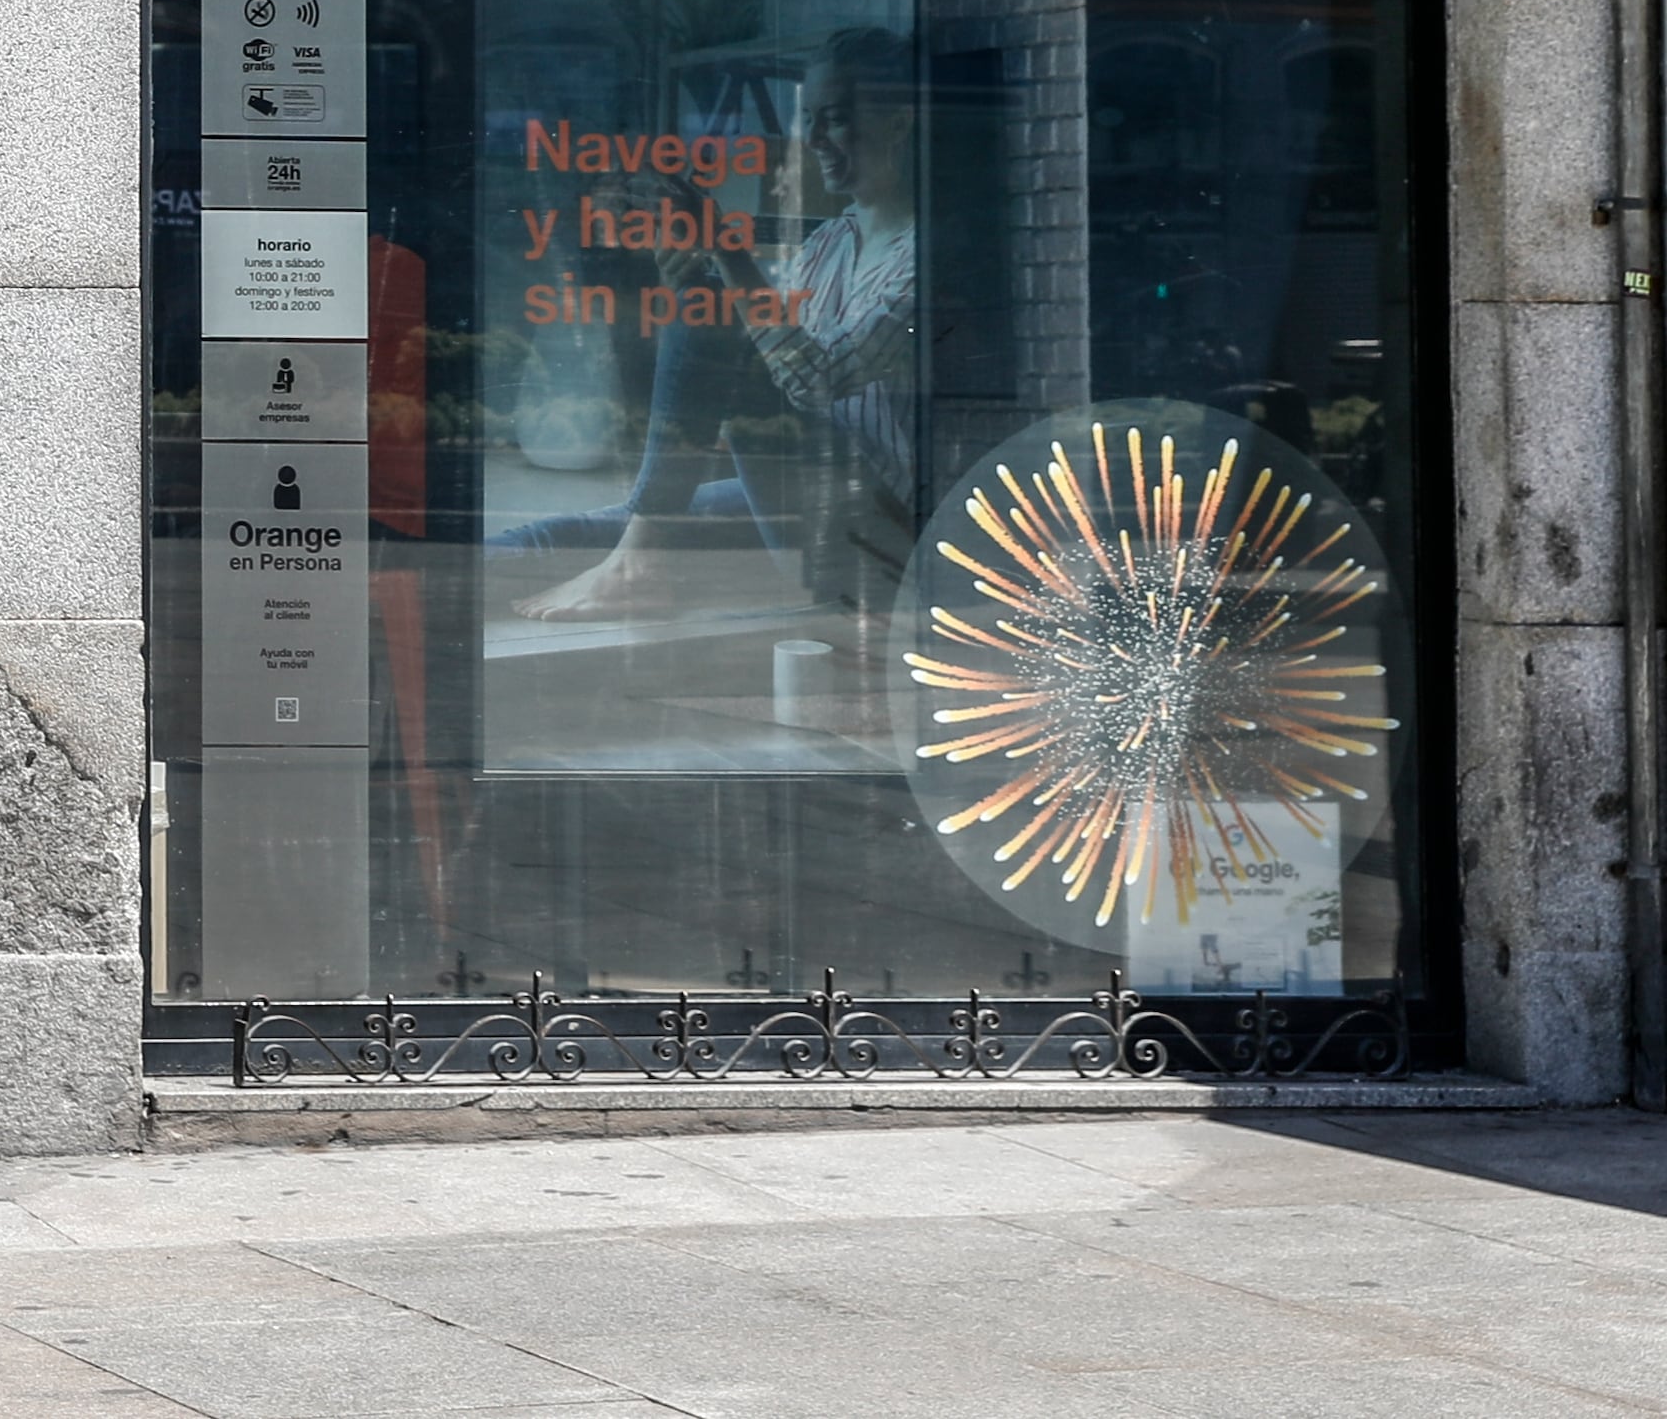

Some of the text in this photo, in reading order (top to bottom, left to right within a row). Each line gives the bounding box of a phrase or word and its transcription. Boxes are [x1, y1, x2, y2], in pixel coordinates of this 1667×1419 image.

[293, 47, 320, 57] VISA
[243, 61, 275, 72] gratis
[526, 120, 767, 187] Navega
[268, 165, 300, 179] 24h
[522, 196, 754, 259] y habla
[258, 239, 311, 251] horario
[245, 258, 325, 269] lunes a sábado
[249, 273, 278, 282] 10:00
[291, 273, 321, 282] 21:00
[235, 287, 334, 298] domingo y festivos
[250, 301, 321, 311] 12:00 a 20:00
[525, 273, 811, 337] sin parar
[267, 402, 302, 411] Asesor
[259, 414, 309, 423] empresas
[229, 521, 341, 553] Orange
[230, 555, 341, 571] en Persona
[265, 599, 310, 609] Atención
[264, 611, 310, 620] al cliente
[260, 649, 314, 659] Ayuda con
[267, 659, 307, 669] tu móvil
